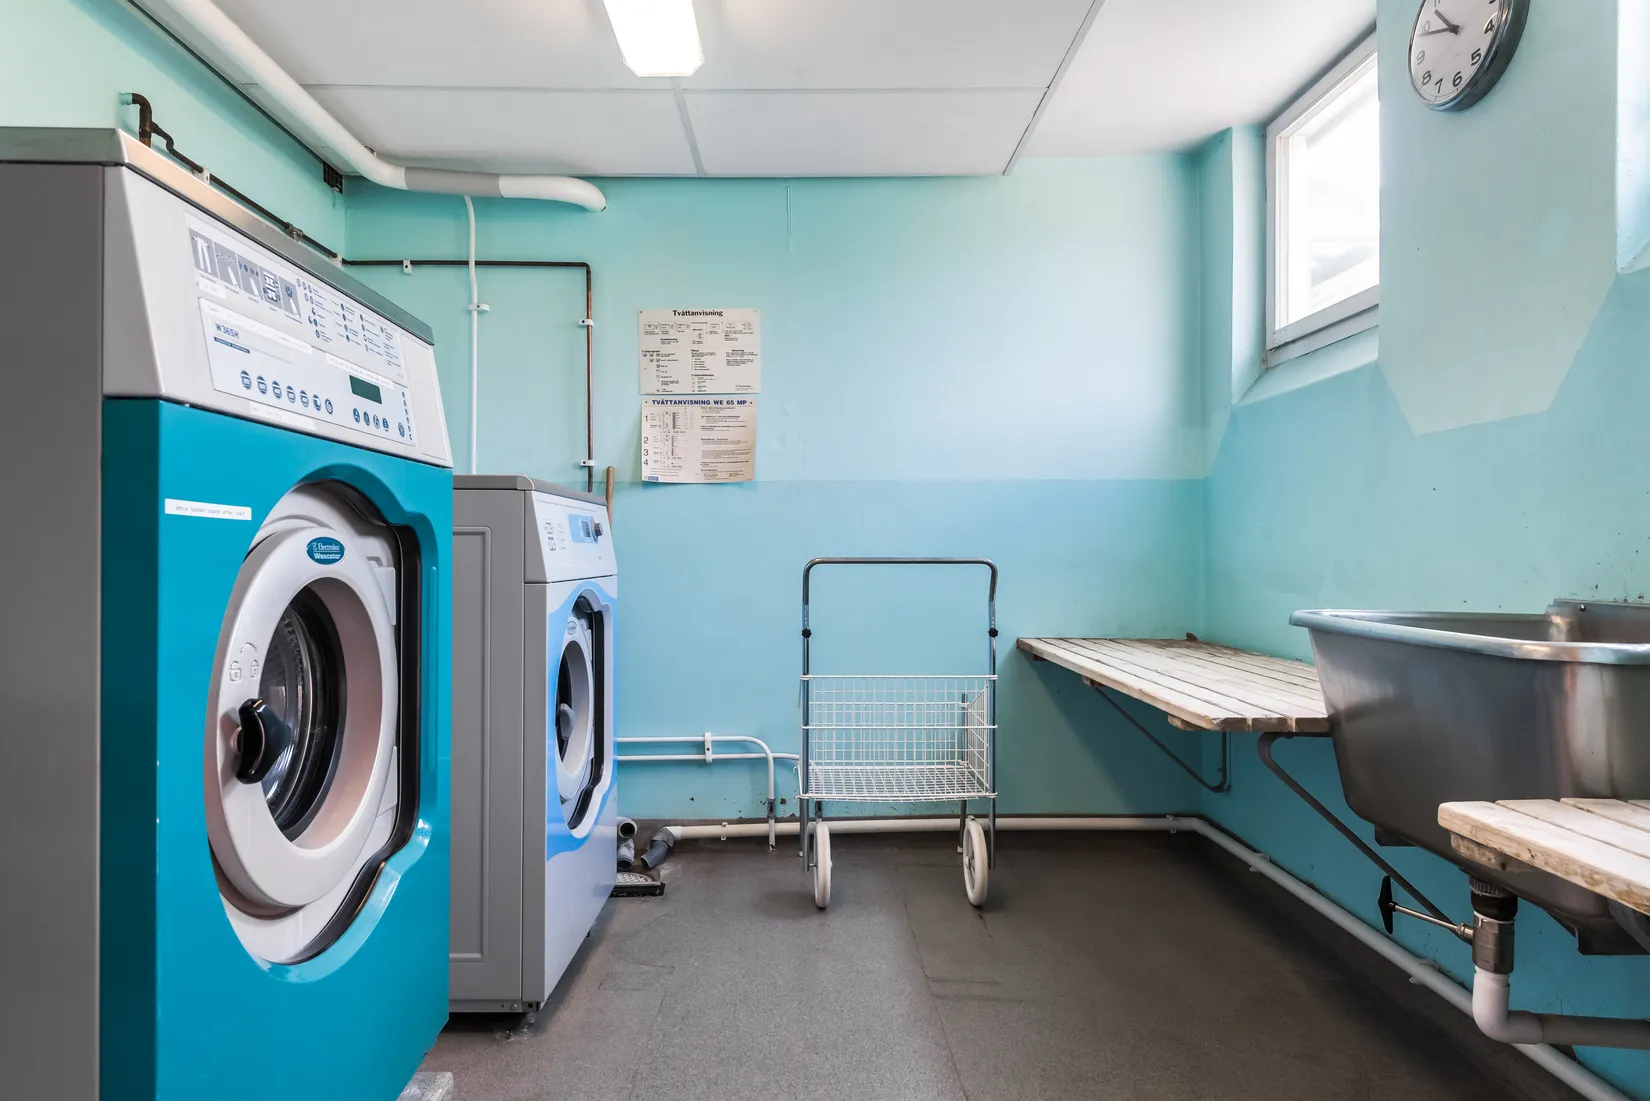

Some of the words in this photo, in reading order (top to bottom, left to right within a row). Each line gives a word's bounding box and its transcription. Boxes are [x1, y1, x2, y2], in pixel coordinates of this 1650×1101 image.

[1484, 18, 1495, 35] 4
[1416, 50, 1426, 65] 9
[1471, 48, 1482, 66] 5
[1422, 70, 1432, 86] 8
[1435, 78, 1444, 94] 7
[1452, 71, 1463, 88] 6
[672, 309, 724, 317] Tvättanvisning
[215, 322, 239, 339] W365H
[318, 542, 340, 550] Electrolux
[314, 552, 341, 560] Wascator
